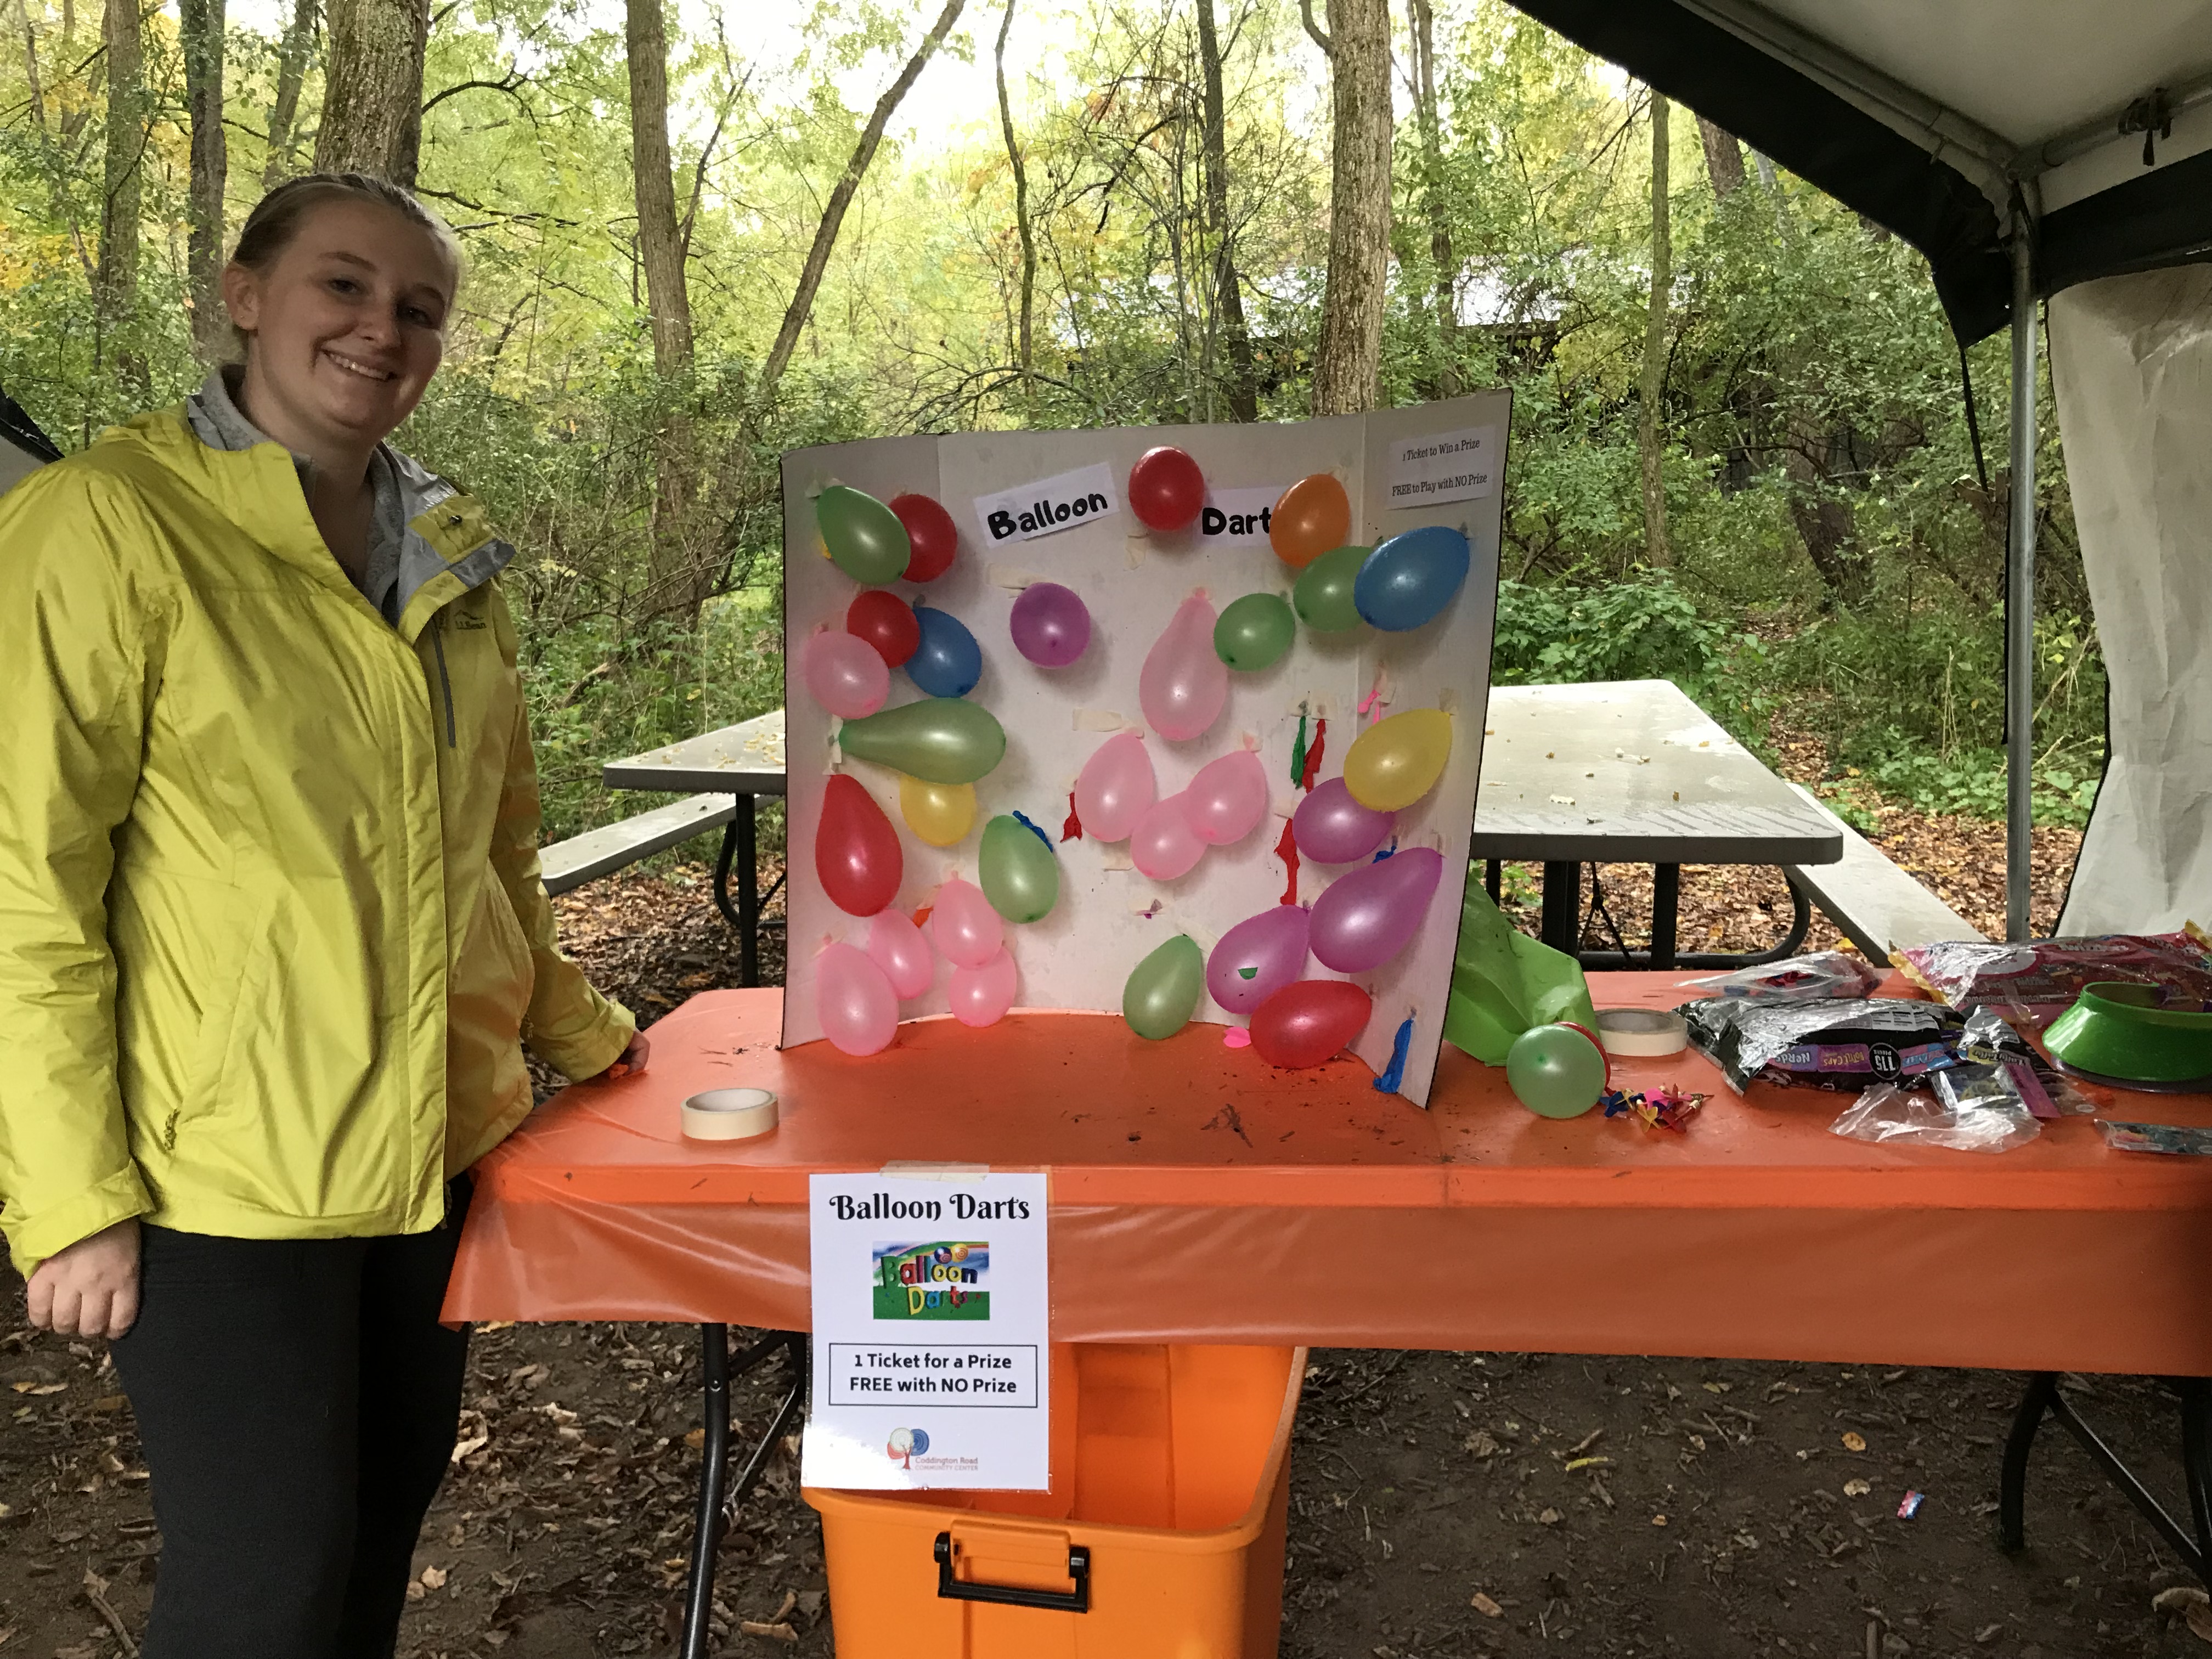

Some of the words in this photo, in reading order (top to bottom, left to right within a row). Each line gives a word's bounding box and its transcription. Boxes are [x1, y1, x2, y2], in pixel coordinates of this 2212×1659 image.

[1407, 448, 1428, 460] Ticket
[1429, 447, 1437, 456] to
[1438, 443, 1453, 454] Win
[1454, 443, 1459, 452] a
[1461, 438, 1480, 450] Prize
[1392, 483, 1412, 496] FREE
[1412, 484, 1420, 493] to
[1420, 481, 1436, 493] Play
[1437, 477, 1453, 490] with
[1455, 475, 1467, 487] NO
[1468, 473, 1488, 486] Prize
[988, 493, 1108, 540] Balloon
[1202, 507, 1272, 535] Dart
[1875, 1055, 1896, 1071] 115
[829, 1193, 941, 1221] Balloon
[949, 1193, 1030, 1219] Darts
[881, 1255, 978, 1289] Balloon
[907, 1285, 969, 1316] Darts
[855, 1354, 862, 1367] 1
[867, 1353, 920, 1368] Ticket
[924, 1353, 949, 1368] for
[953, 1358, 963, 1368] a
[968, 1354, 1012, 1368] Prize
[850, 1377, 893, 1391] FREE
[898, 1376, 936, 1392] with
[941, 1378, 968, 1392] NO
[973, 1378, 1017, 1393] Prize
[915, 1457, 958, 1465] Coddington
